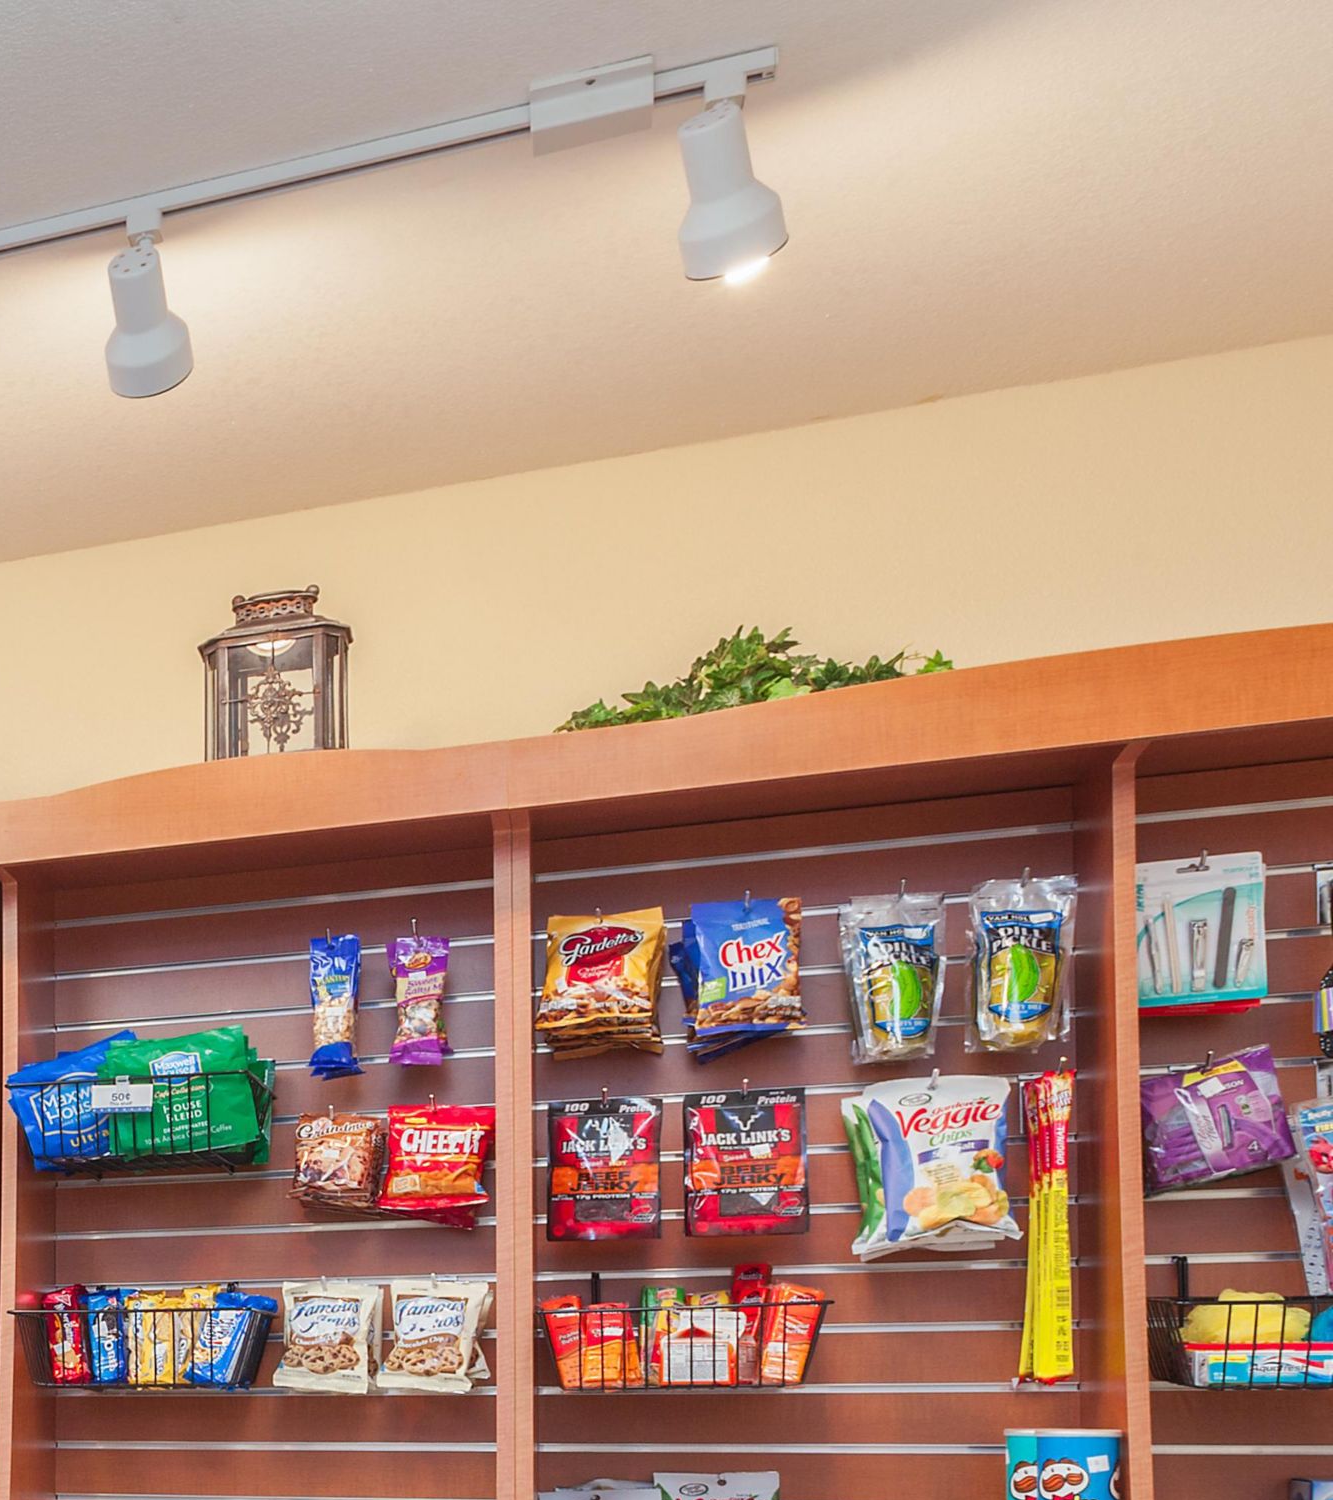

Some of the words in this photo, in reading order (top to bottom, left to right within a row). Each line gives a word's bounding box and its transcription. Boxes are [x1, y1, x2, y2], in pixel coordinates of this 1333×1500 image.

[996, 925, 1044, 940] DILL
[718, 929, 789, 968] Chex
[991, 936, 1054, 953] PICKLE
[153, 1056, 196, 1073] Maxwell
[41, 1085, 93, 1112] Maxw
[111, 1093, 131, 1102] 50¢
[699, 1095, 726, 1106] 100
[757, 1094, 798, 1107] Protein
[45, 1101, 93, 1124] Hous
[162, 1100, 203, 1114] HOUSE
[564, 1102, 589, 1113] 100
[619, 1102, 657, 1116] Protein
[165, 1109, 203, 1123] BLEND
[895, 1099, 1004, 1138] Veggie
[210, 1124, 233, 1134] Coffee
[701, 1131, 735, 1147] JACK
[738, 1128, 792, 1145] LINK'S
[929, 1128, 975, 1147] Chips
[562, 1139, 596, 1153] JACK
[577, 1169, 630, 1182] BEEF
[720, 1163, 778, 1176] BEEF
[569, 1179, 638, 1193] JERKY
[713, 1173, 787, 1187] JERKY
[1250, 1361, 1309, 1374] Aquafresh
